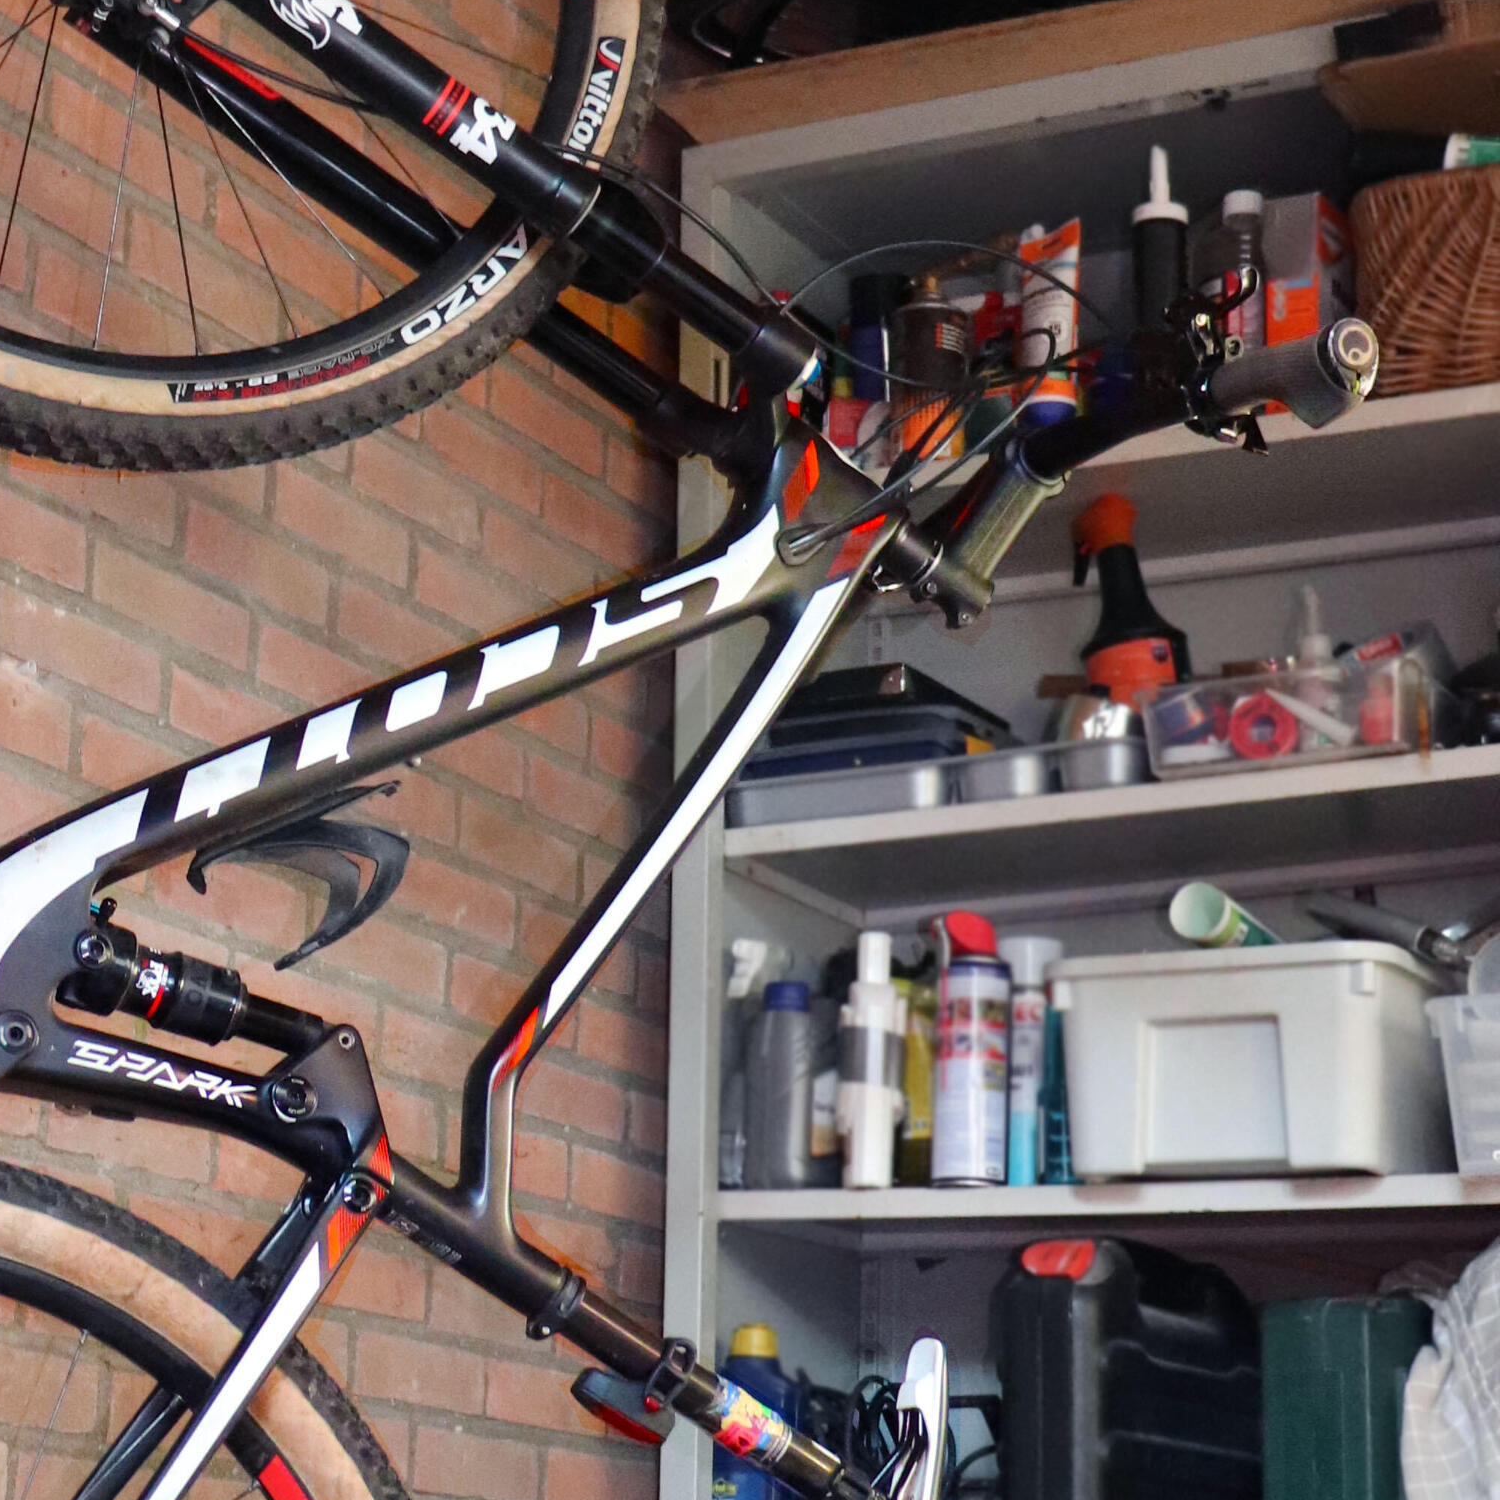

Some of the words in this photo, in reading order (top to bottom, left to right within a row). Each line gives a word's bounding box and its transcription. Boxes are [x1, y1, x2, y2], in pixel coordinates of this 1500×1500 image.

[450, 97, 516, 165] 34
[400, 223, 528, 346] ARZO
[66, 1039, 257, 1108] SPARK
